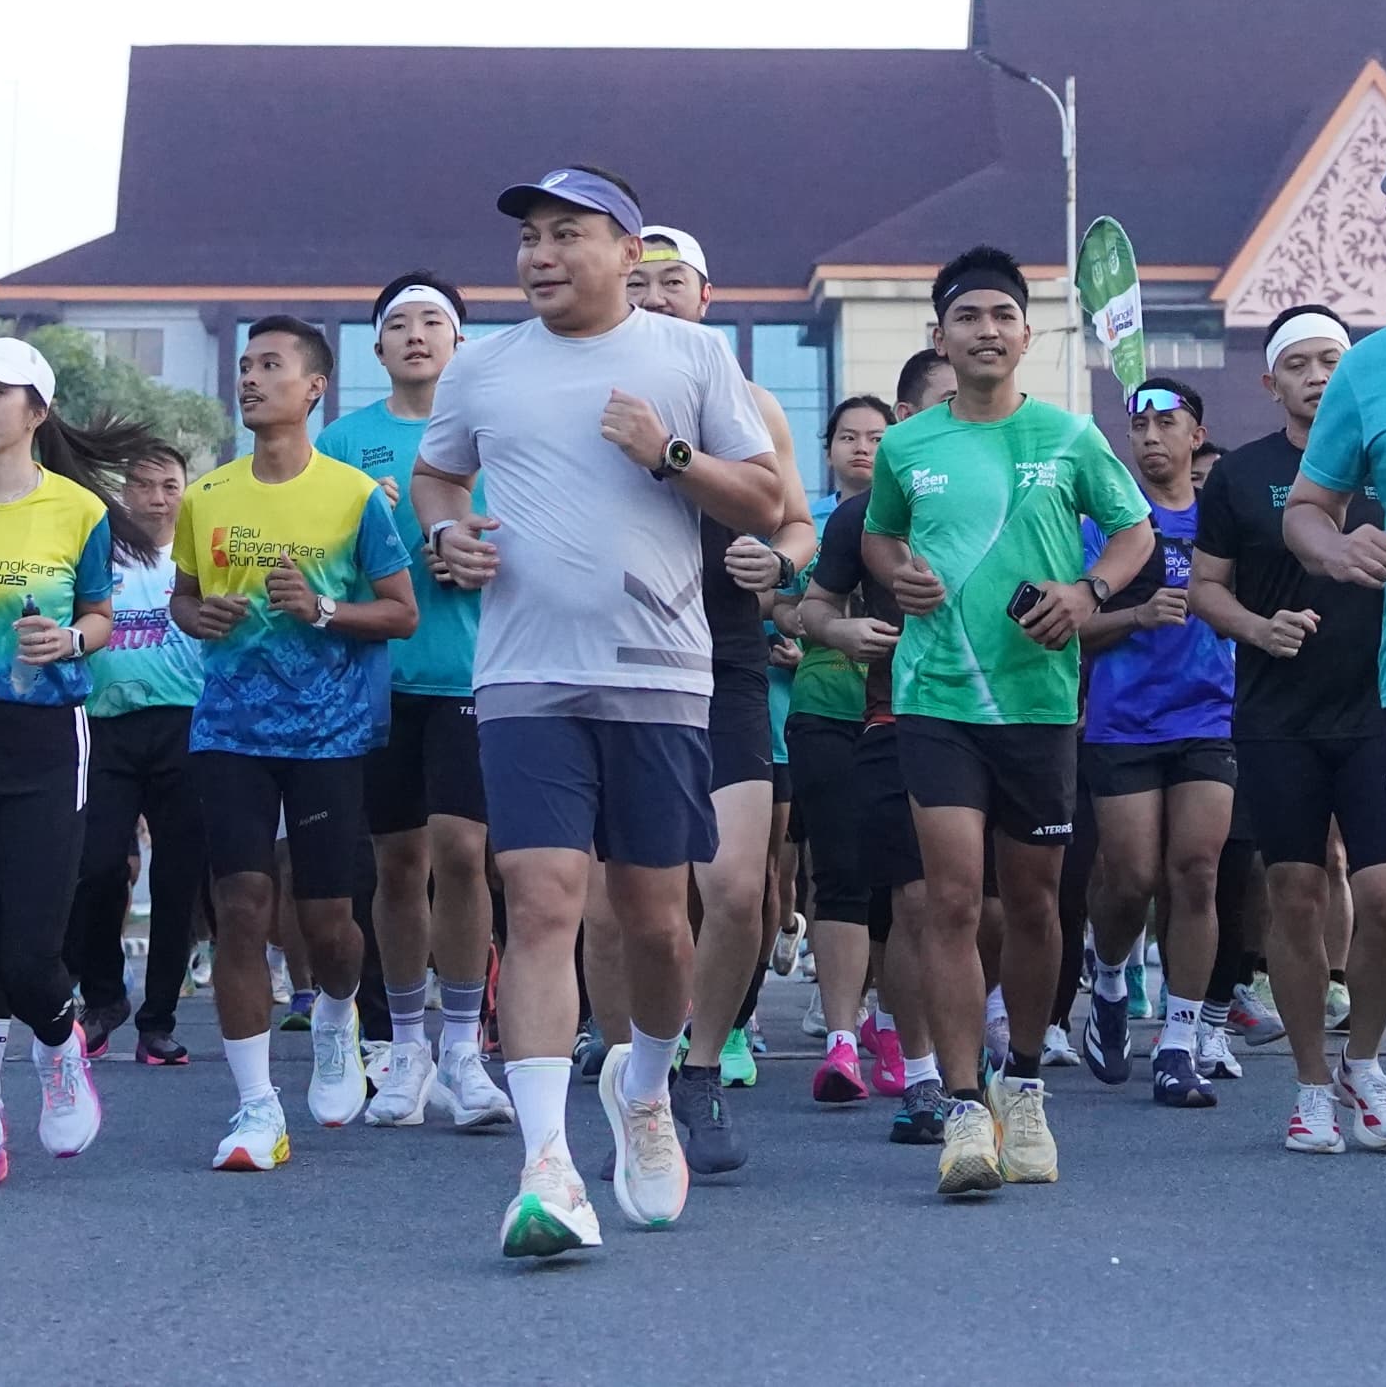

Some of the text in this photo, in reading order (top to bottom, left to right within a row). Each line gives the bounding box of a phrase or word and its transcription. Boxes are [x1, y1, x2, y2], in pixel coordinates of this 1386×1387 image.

[362, 446, 387, 456] Green
[362, 456, 394, 469] Runners
[912, 473, 948, 490] Geen
[230, 526, 261, 539] Riau
[229, 540, 325, 559] Bhayangkara
[229, 554, 254, 567] Run
[112, 608, 166, 619] ARINE
[108, 628, 165, 650] RUN
[459, 706, 477, 715] TE
